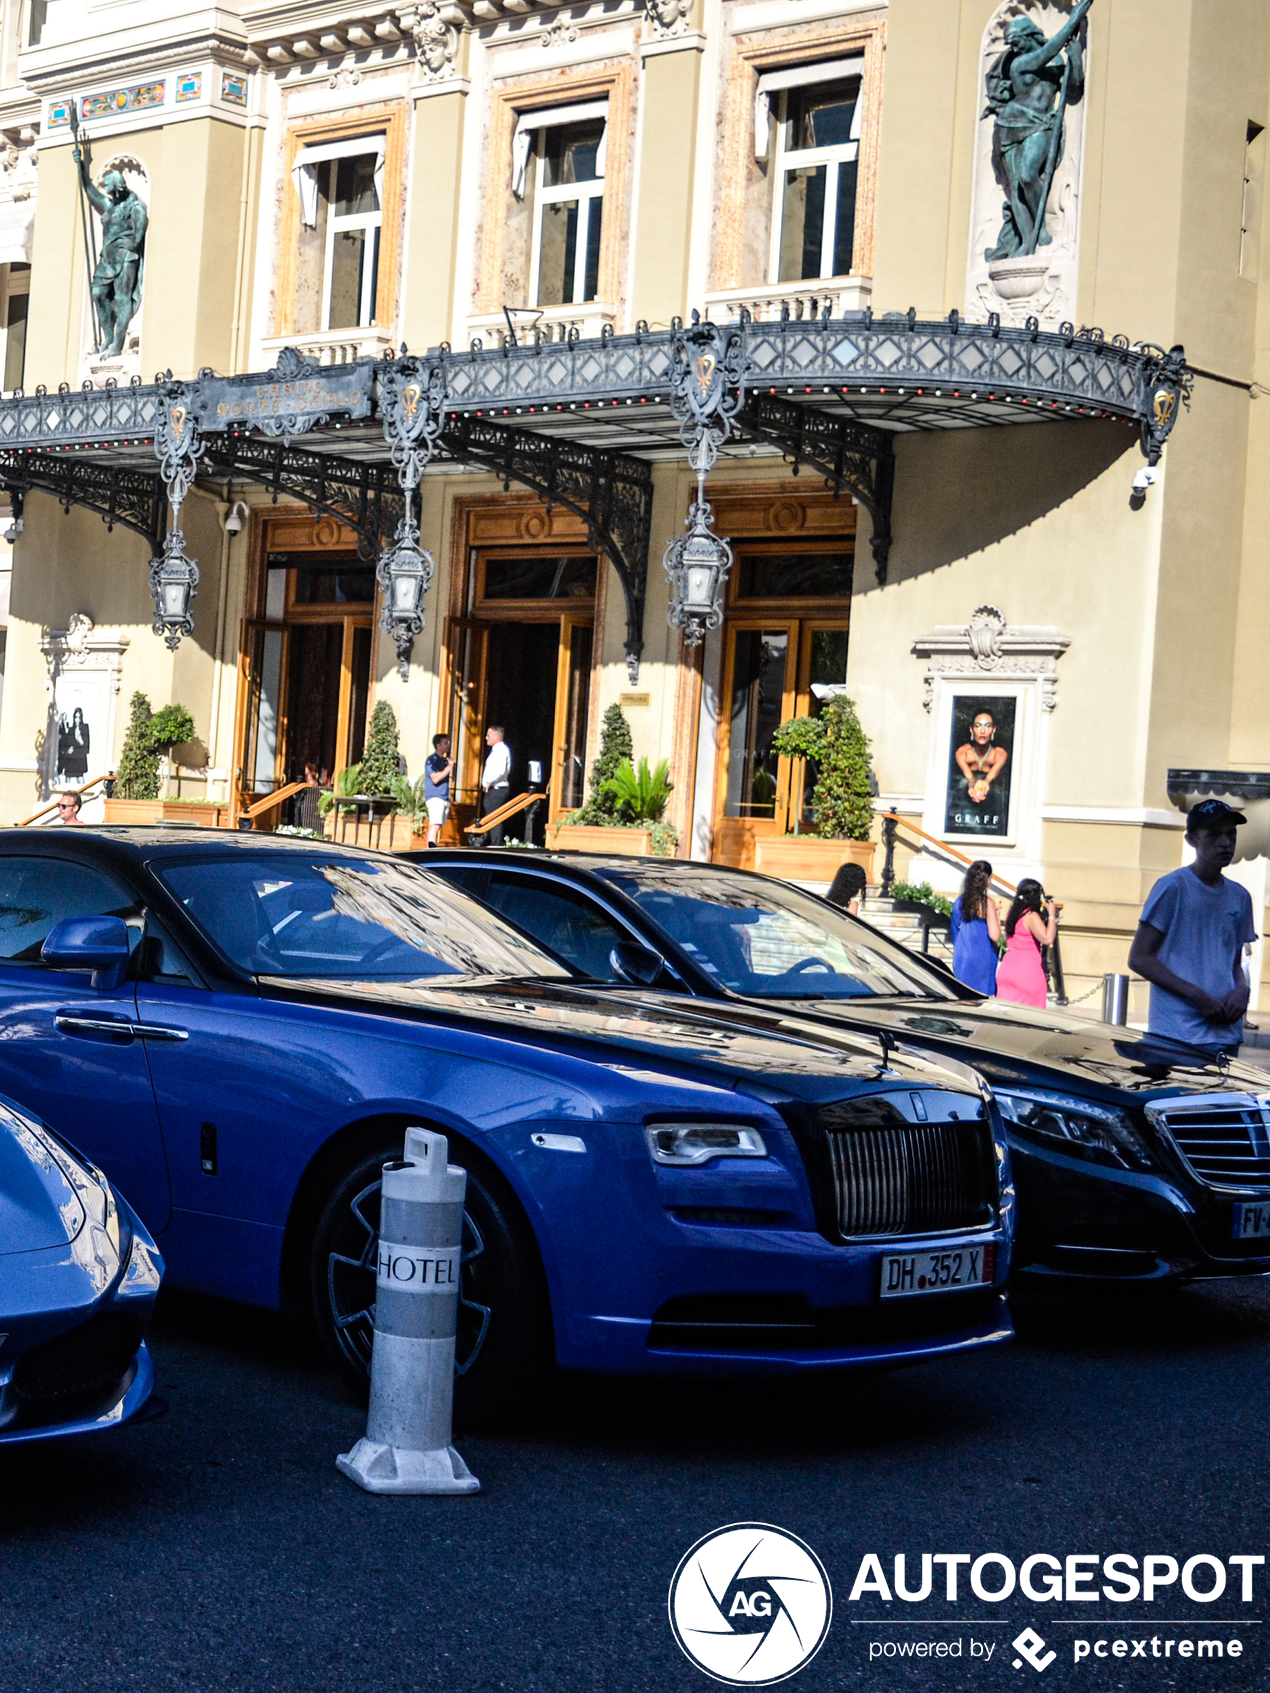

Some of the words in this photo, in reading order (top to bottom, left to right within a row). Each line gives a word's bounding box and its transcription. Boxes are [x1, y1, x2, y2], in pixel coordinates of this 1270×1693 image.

[256, 380, 324, 399] CASINO
[954, 813, 999, 825] GRAFF
[378, 1251, 457, 1284] HOTEL
[887, 1257, 915, 1291] DH
[927, 1252, 963, 1287] 352
[967, 1249, 980, 1282] X
